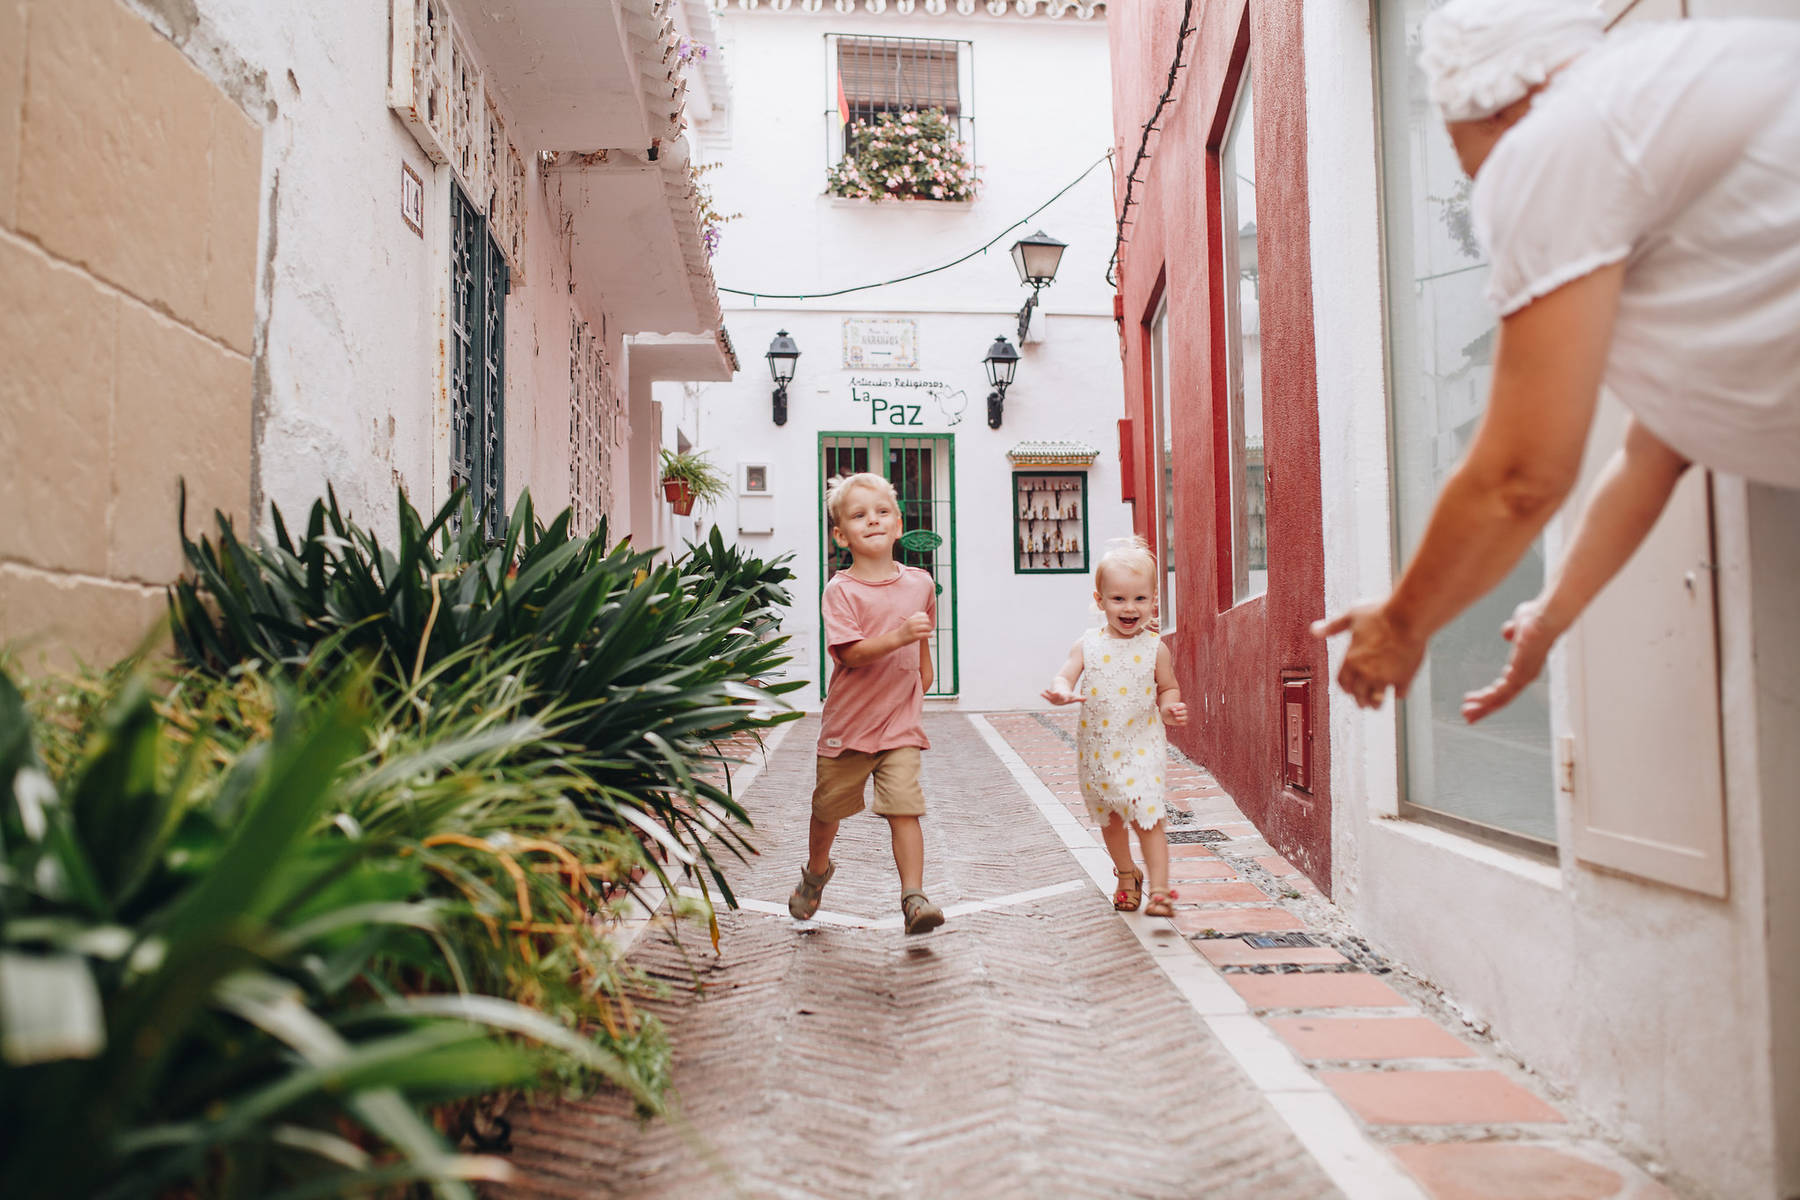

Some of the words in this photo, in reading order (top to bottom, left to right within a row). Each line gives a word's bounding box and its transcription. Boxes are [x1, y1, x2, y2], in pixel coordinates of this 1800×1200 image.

[406, 179, 419, 221] 14
[894, 377, 944, 389] Religiosos
[852, 388, 870, 402] La
[872, 399, 923, 425] Paz
